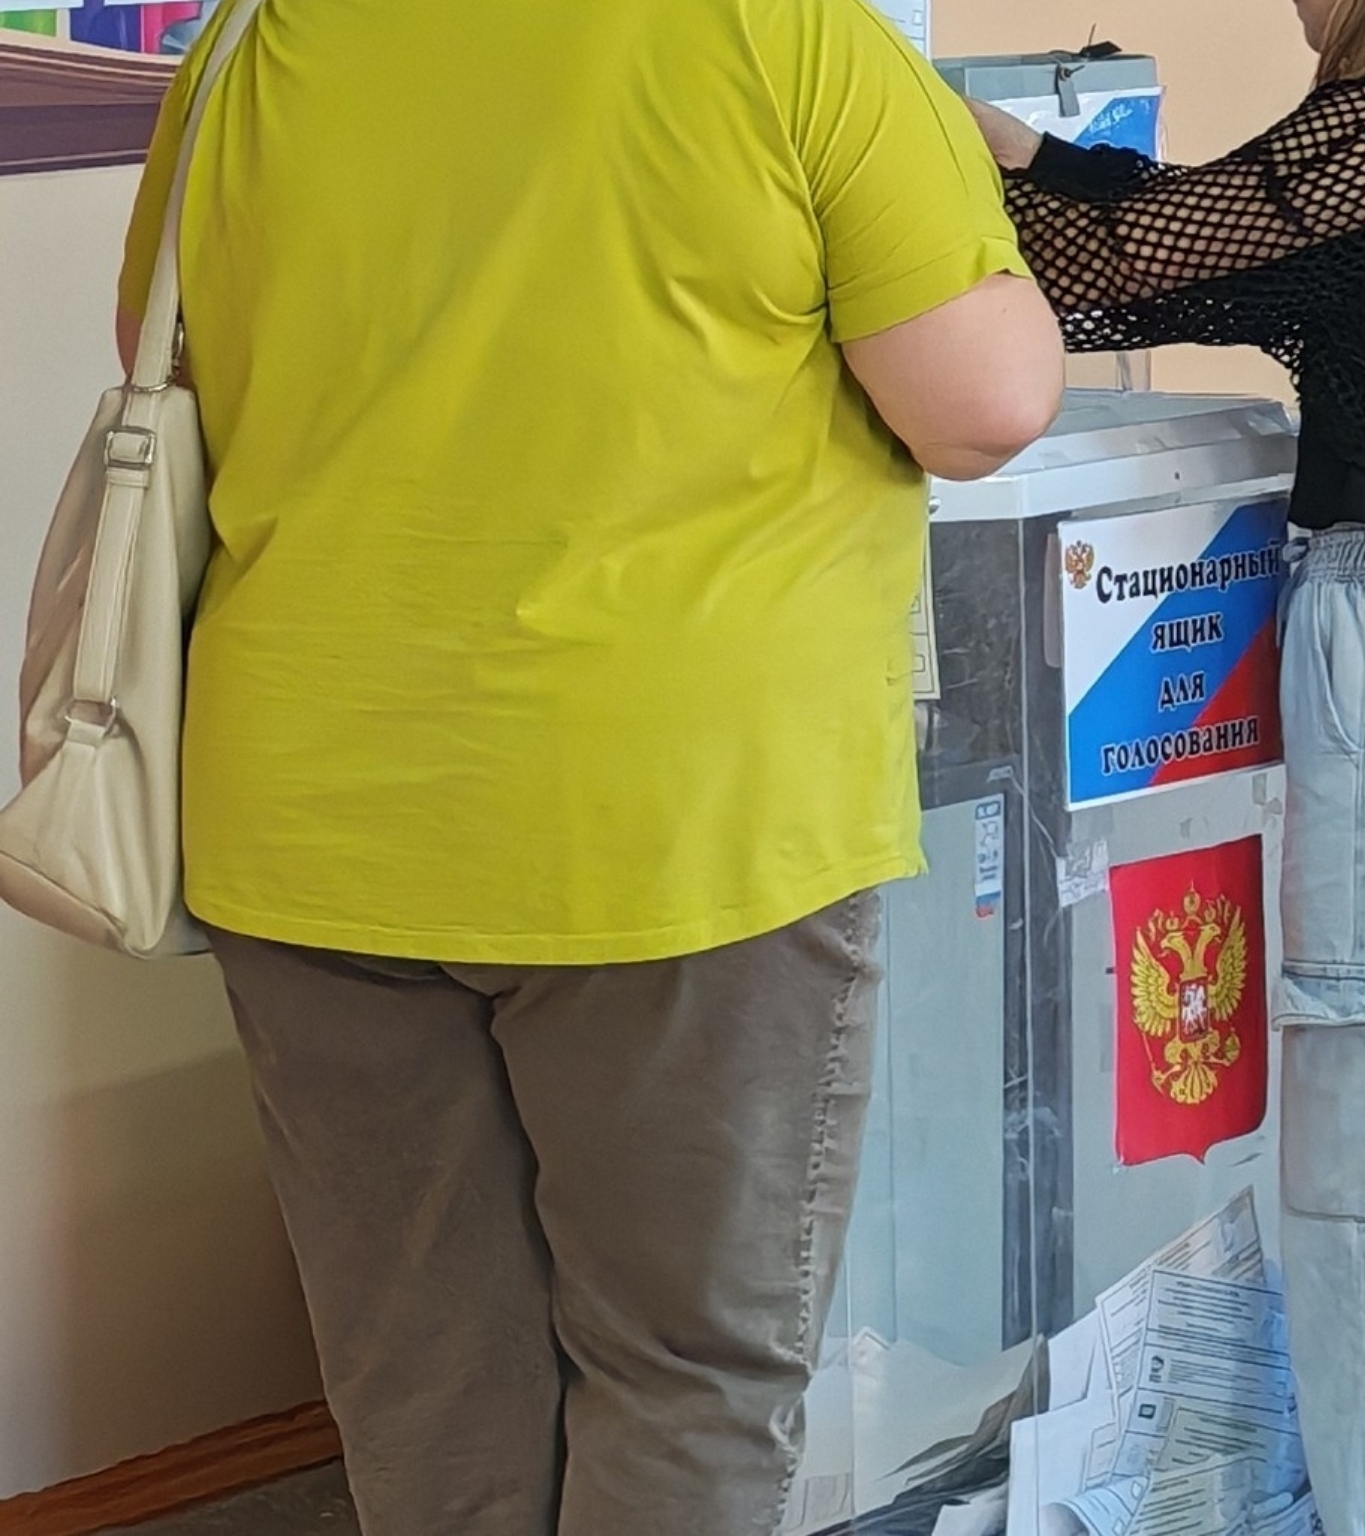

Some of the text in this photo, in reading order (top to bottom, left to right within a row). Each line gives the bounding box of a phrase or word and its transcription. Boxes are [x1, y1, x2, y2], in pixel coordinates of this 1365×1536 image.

[1095, 539, 1281, 605] Стационарный
[1151, 613, 1223, 652] ящик
[1158, 672, 1205, 711] для
[1102, 717, 1260, 775] голосования
